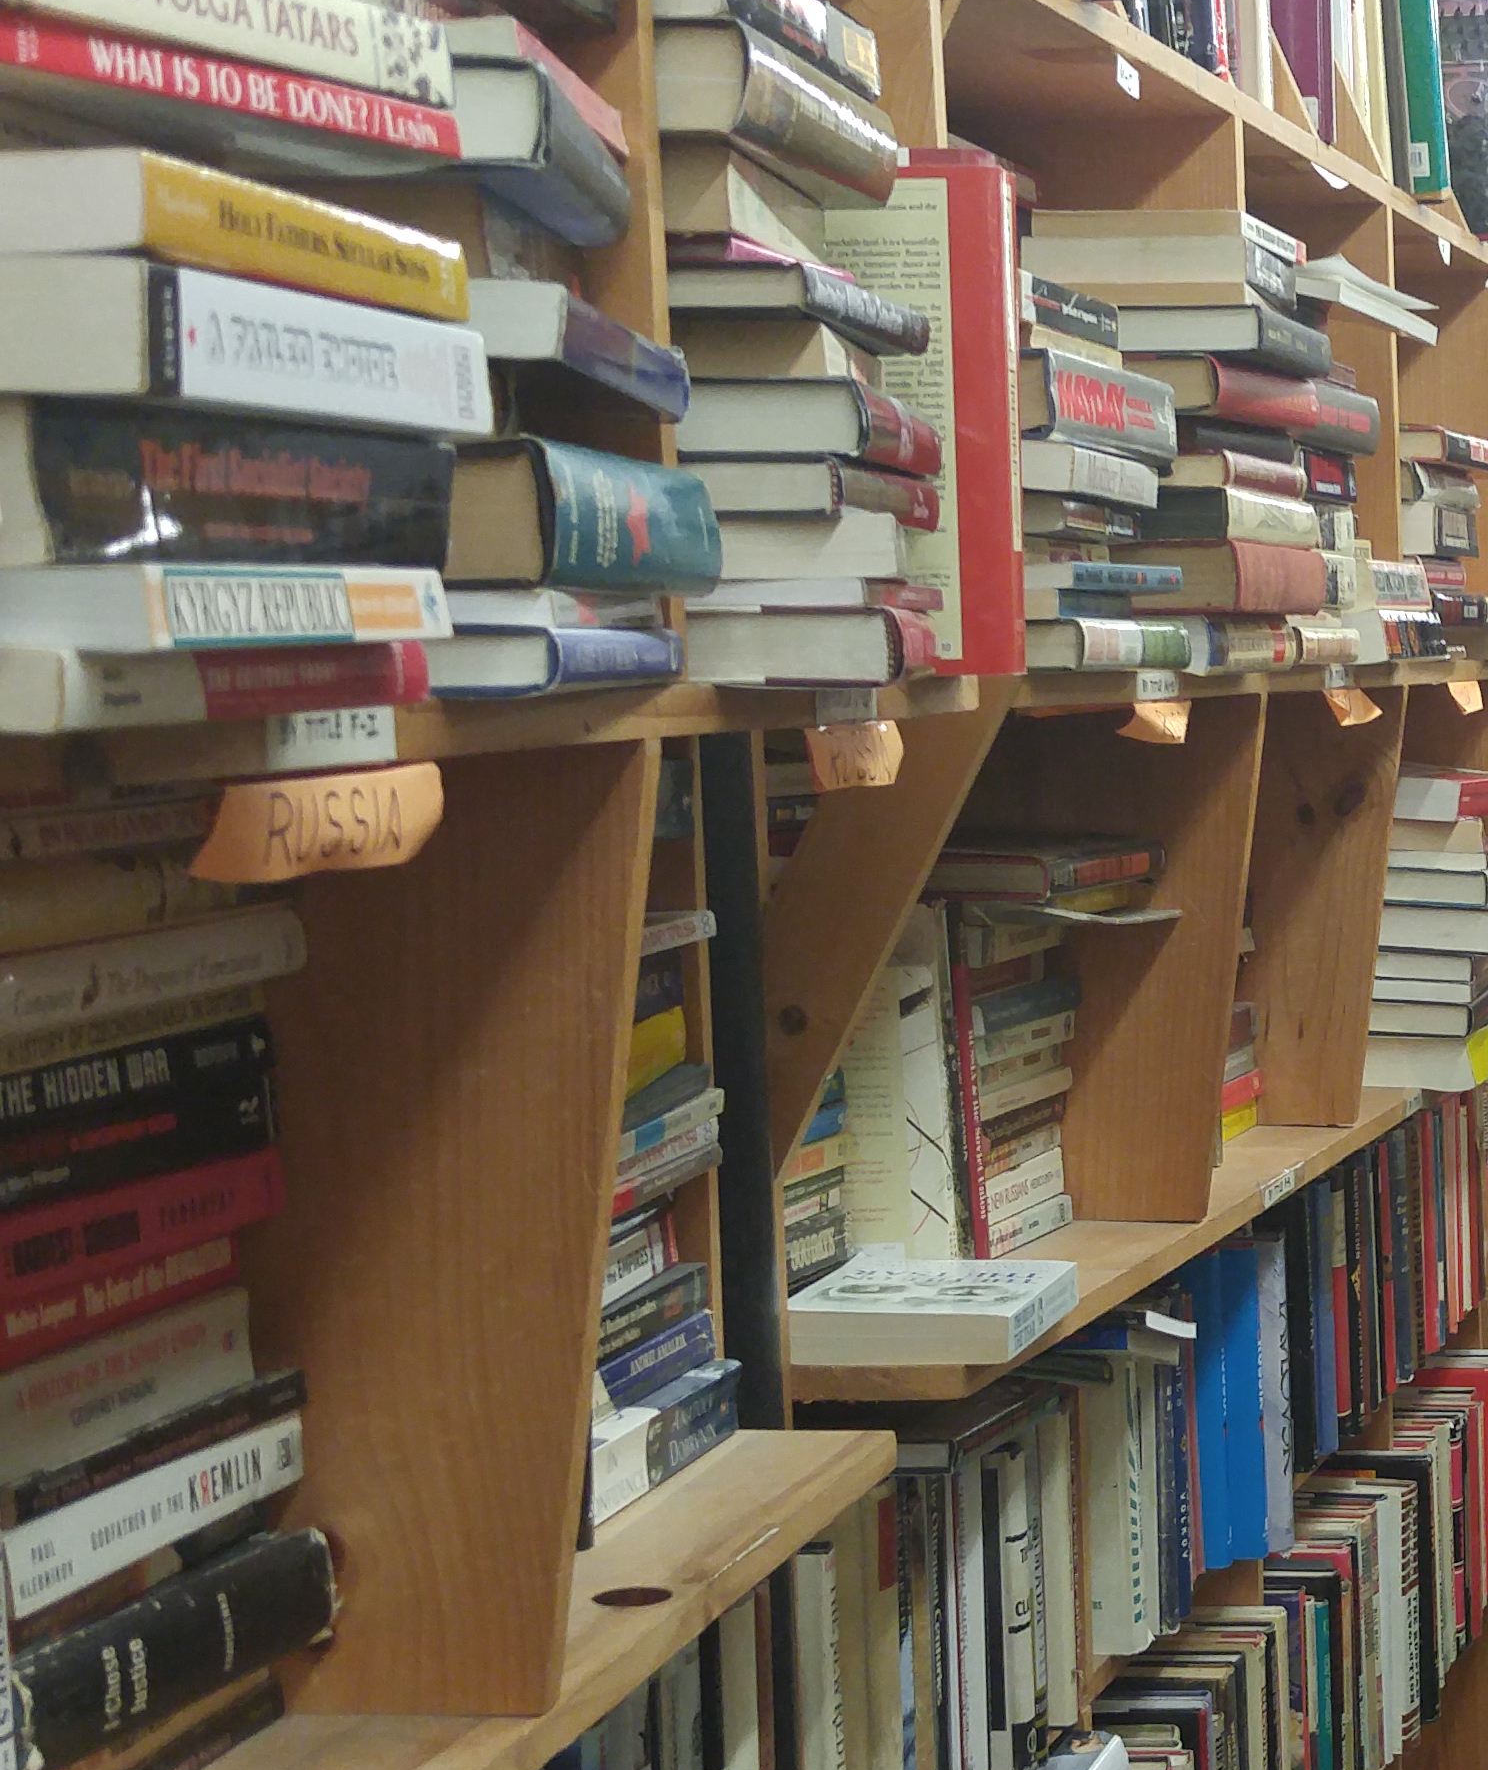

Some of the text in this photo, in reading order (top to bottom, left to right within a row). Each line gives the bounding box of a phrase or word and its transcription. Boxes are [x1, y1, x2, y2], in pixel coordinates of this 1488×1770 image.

[89, 35, 165, 90] WHAT
[174, 57, 199, 99] IS
[206, 64, 241, 104] TO
[249, 77, 280, 114] BE
[264, 786, 402, 868] RUSSIA
[43, 1060, 121, 1110] HIDDEN
[127, 1047, 172, 1089] WAR
